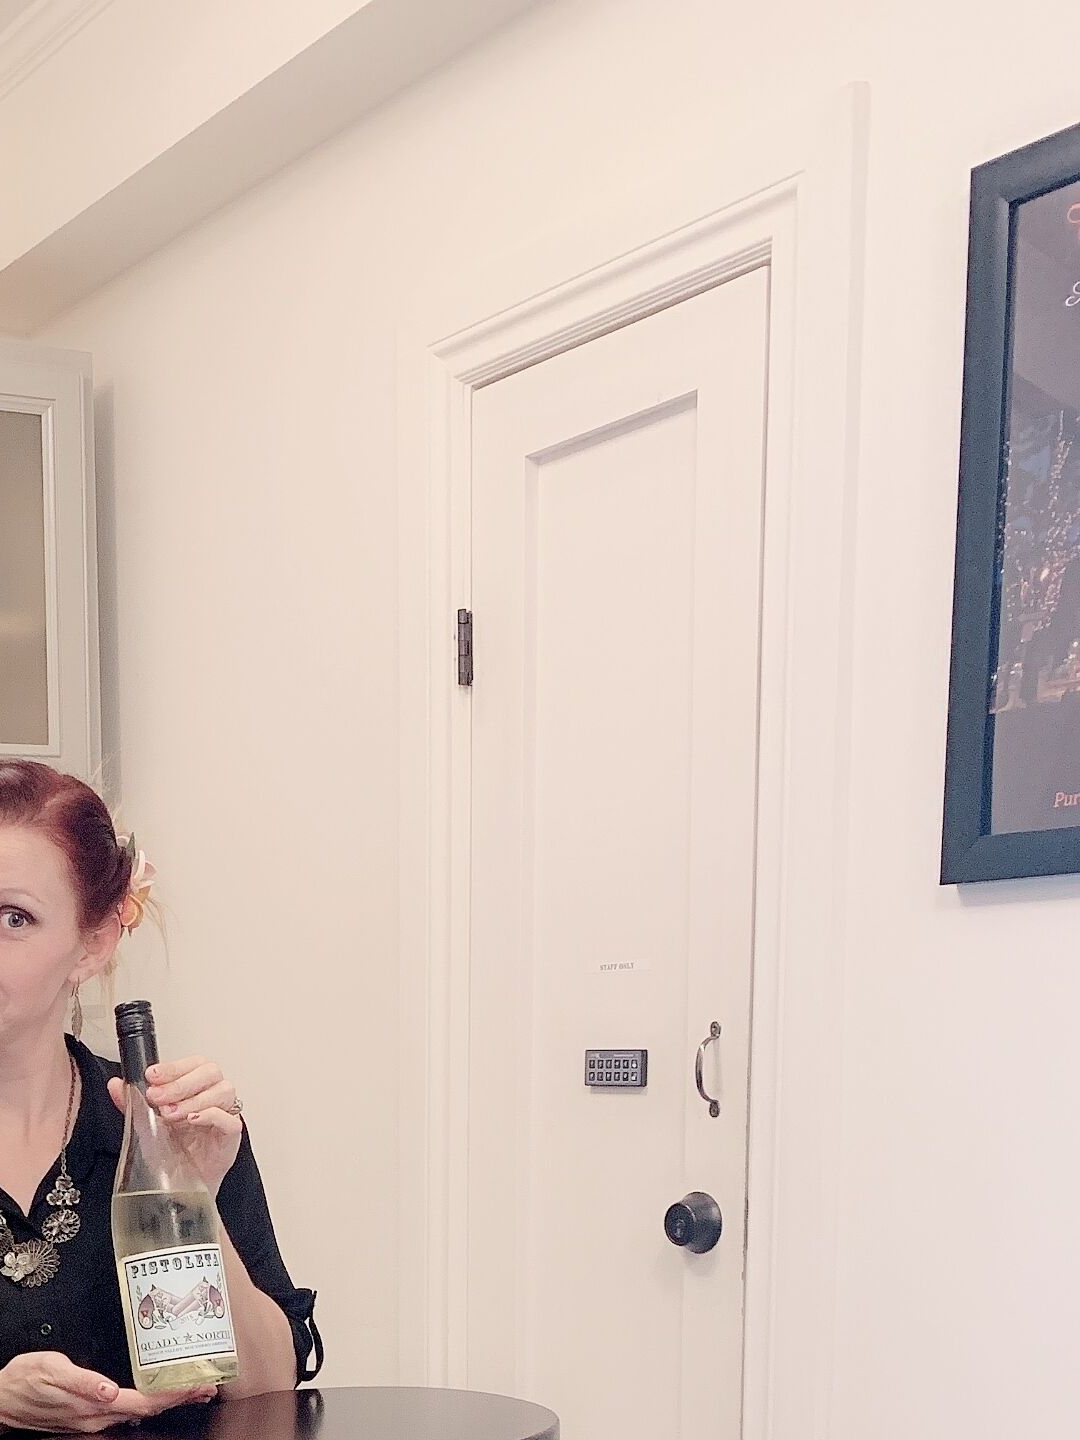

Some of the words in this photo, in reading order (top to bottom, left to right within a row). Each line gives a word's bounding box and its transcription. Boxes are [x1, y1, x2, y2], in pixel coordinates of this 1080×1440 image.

[600, 963, 617, 971] STAFF
[618, 962, 634, 970] ONLY
[140, 1336, 181, 1352] QUADY
